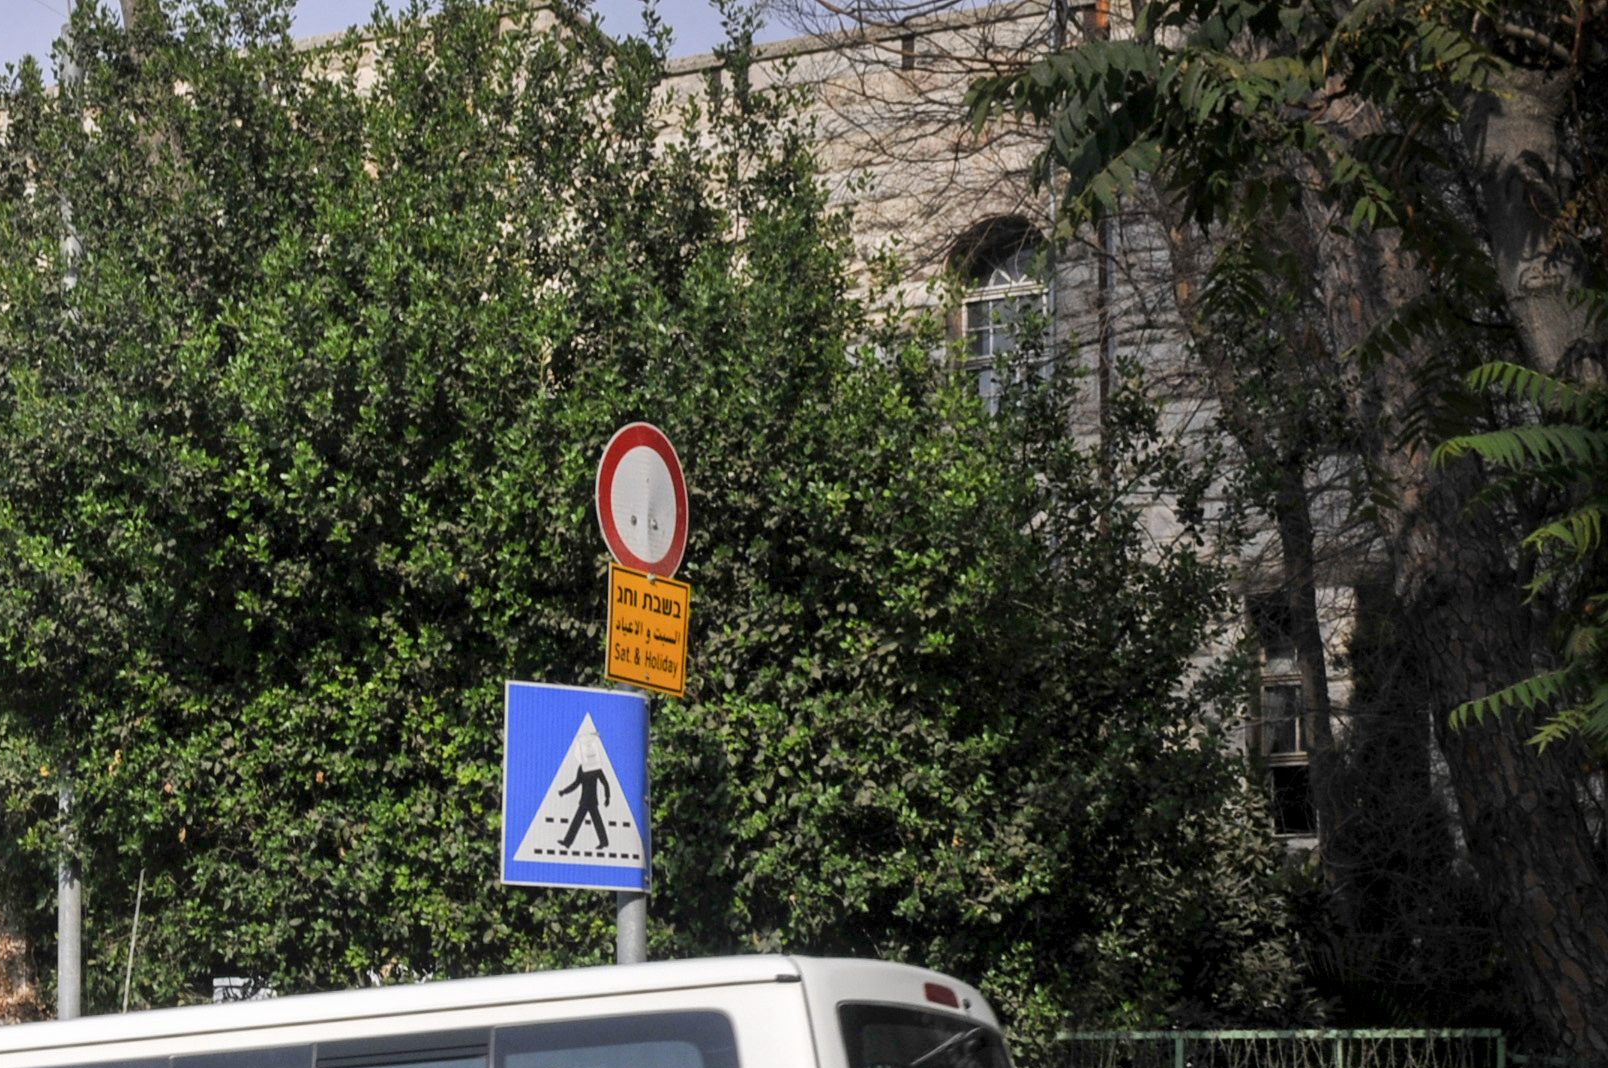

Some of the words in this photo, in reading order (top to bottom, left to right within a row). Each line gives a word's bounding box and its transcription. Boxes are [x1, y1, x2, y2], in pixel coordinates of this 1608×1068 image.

[616, 585, 638, 608] וחג
[642, 592, 681, 619] בשבת
[634, 647, 641, 666] &
[644, 650, 679, 679] Holiday
